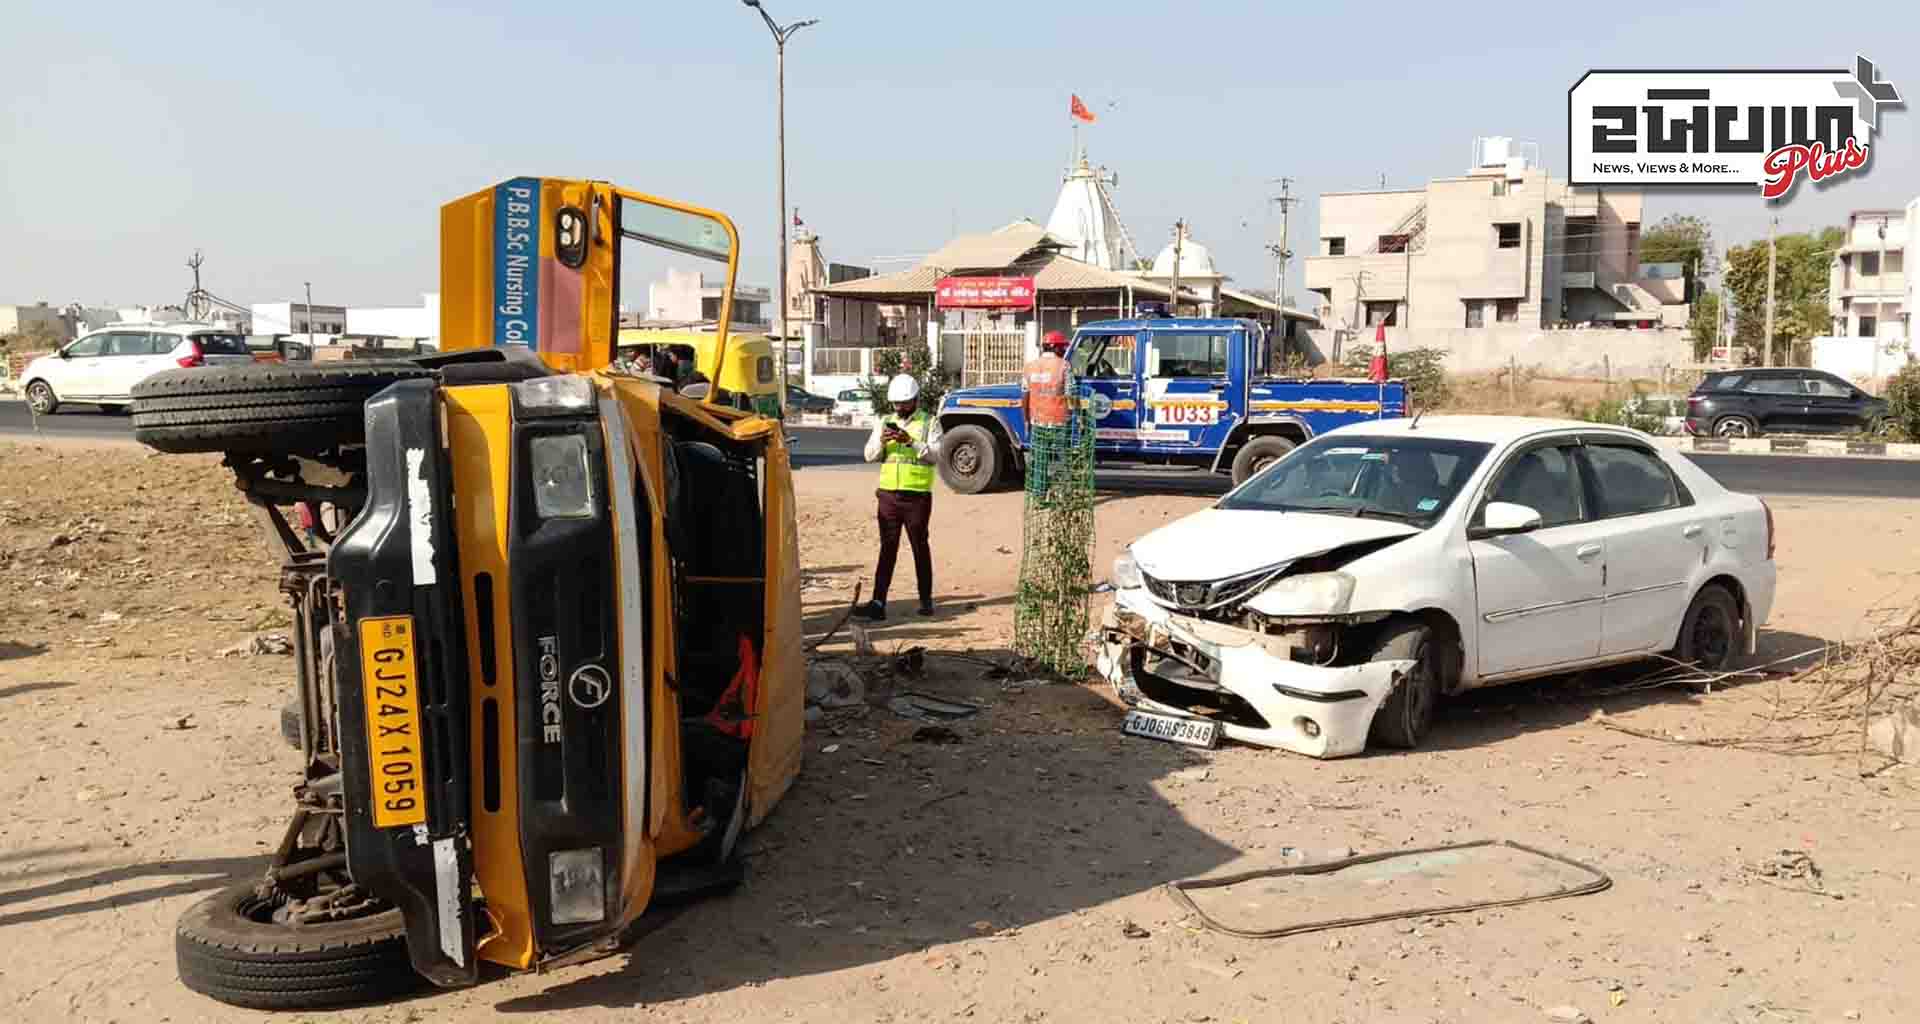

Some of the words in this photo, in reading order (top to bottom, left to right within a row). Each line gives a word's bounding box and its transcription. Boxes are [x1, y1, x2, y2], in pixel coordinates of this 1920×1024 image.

[500, 254, 529, 315] Nursing
[1161, 402, 1211, 423] 1033
[537, 634, 560, 742] FORCE
